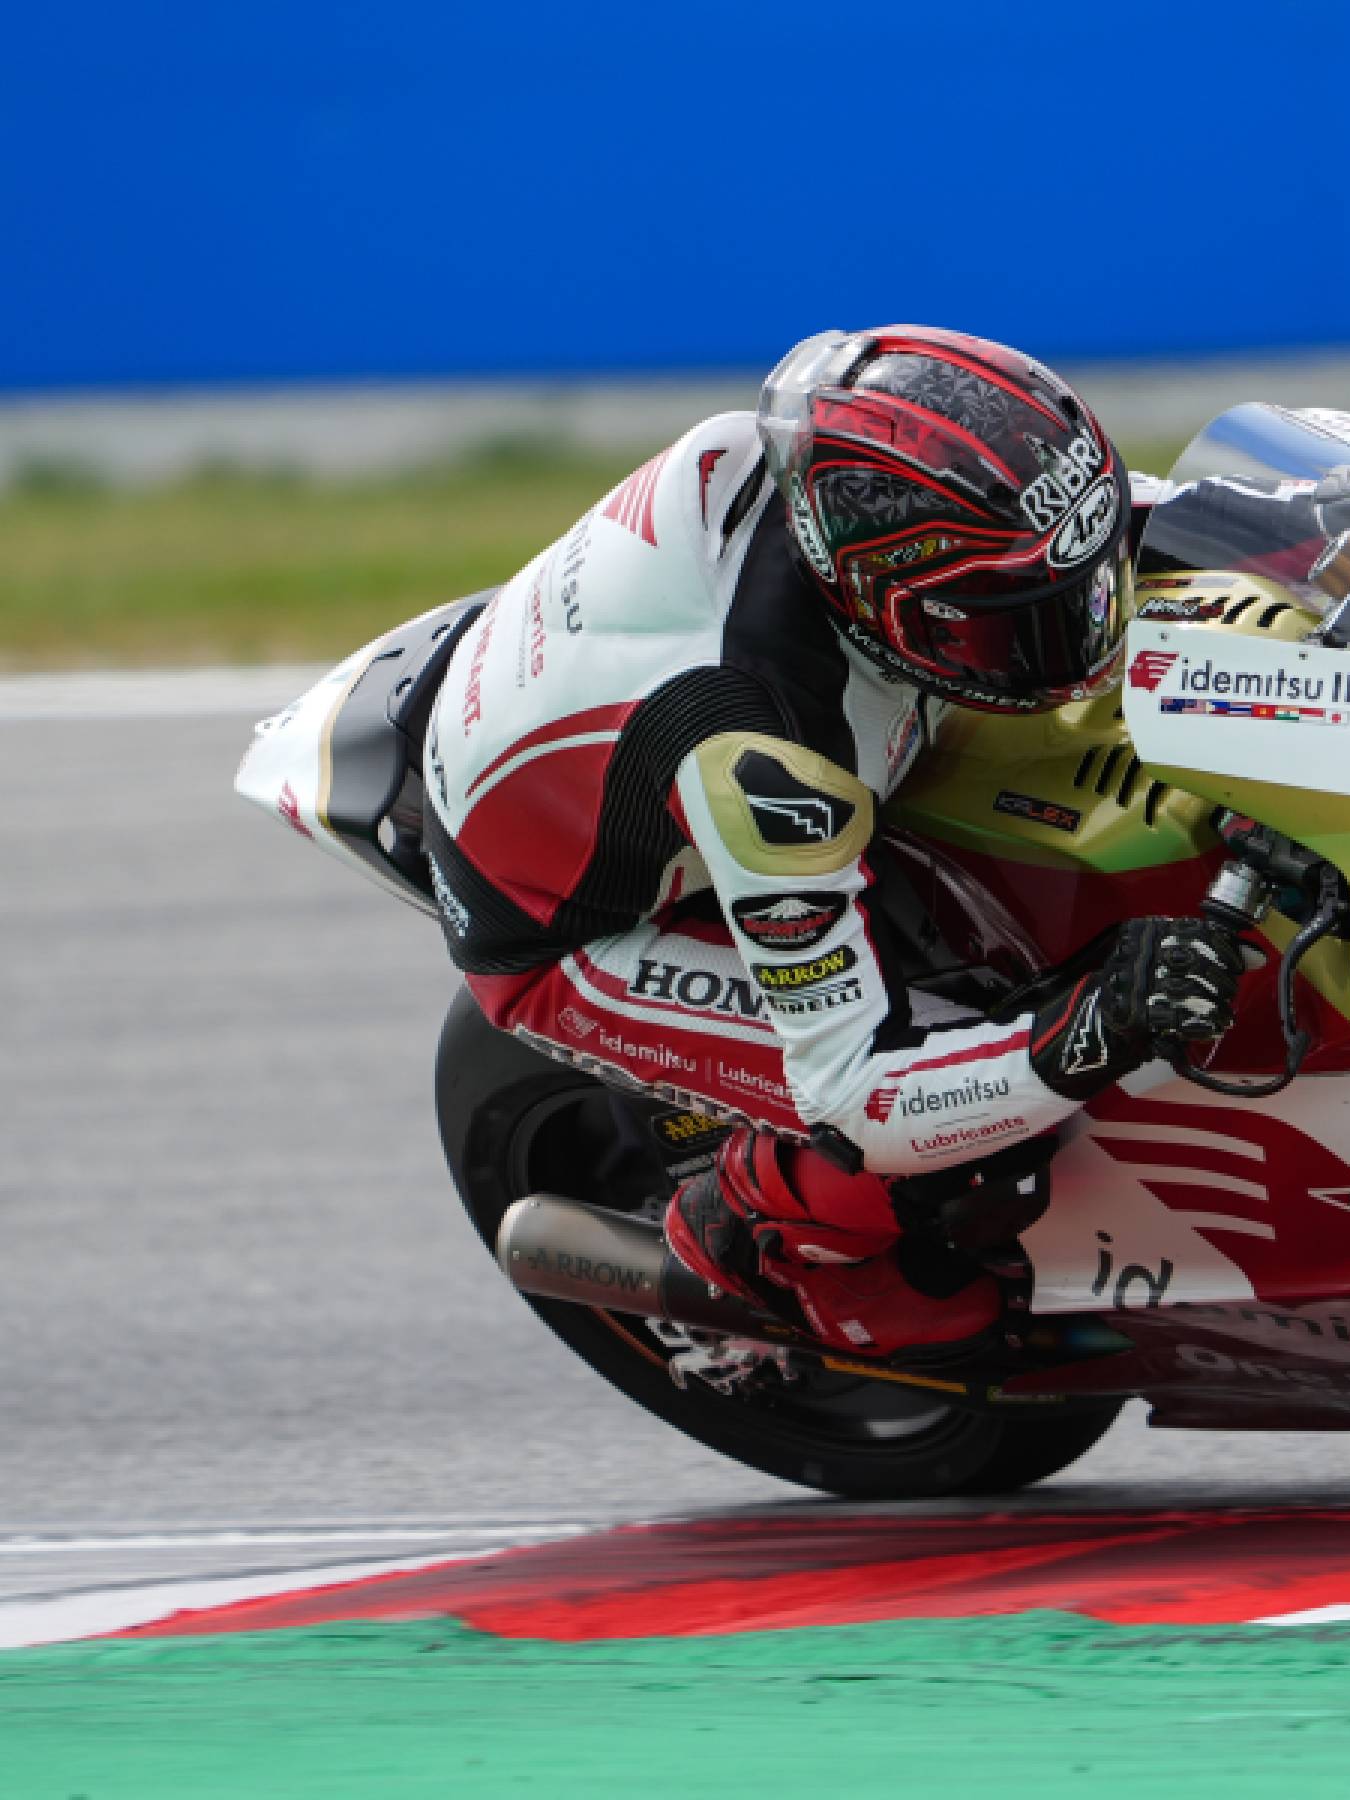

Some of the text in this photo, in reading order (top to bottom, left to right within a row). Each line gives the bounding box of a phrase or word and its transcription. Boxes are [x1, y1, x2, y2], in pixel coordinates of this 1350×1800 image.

[1180, 656, 1324, 700] idemitsu
[629, 957, 770, 1020] HON
[758, 950, 845, 985] ARROW
[599, 1028, 698, 1073] idemitsu
[899, 1076, 1012, 1118] idemitsu
[910, 1115, 1027, 1152] Lubricants
[527, 1247, 647, 1292] ARROW
